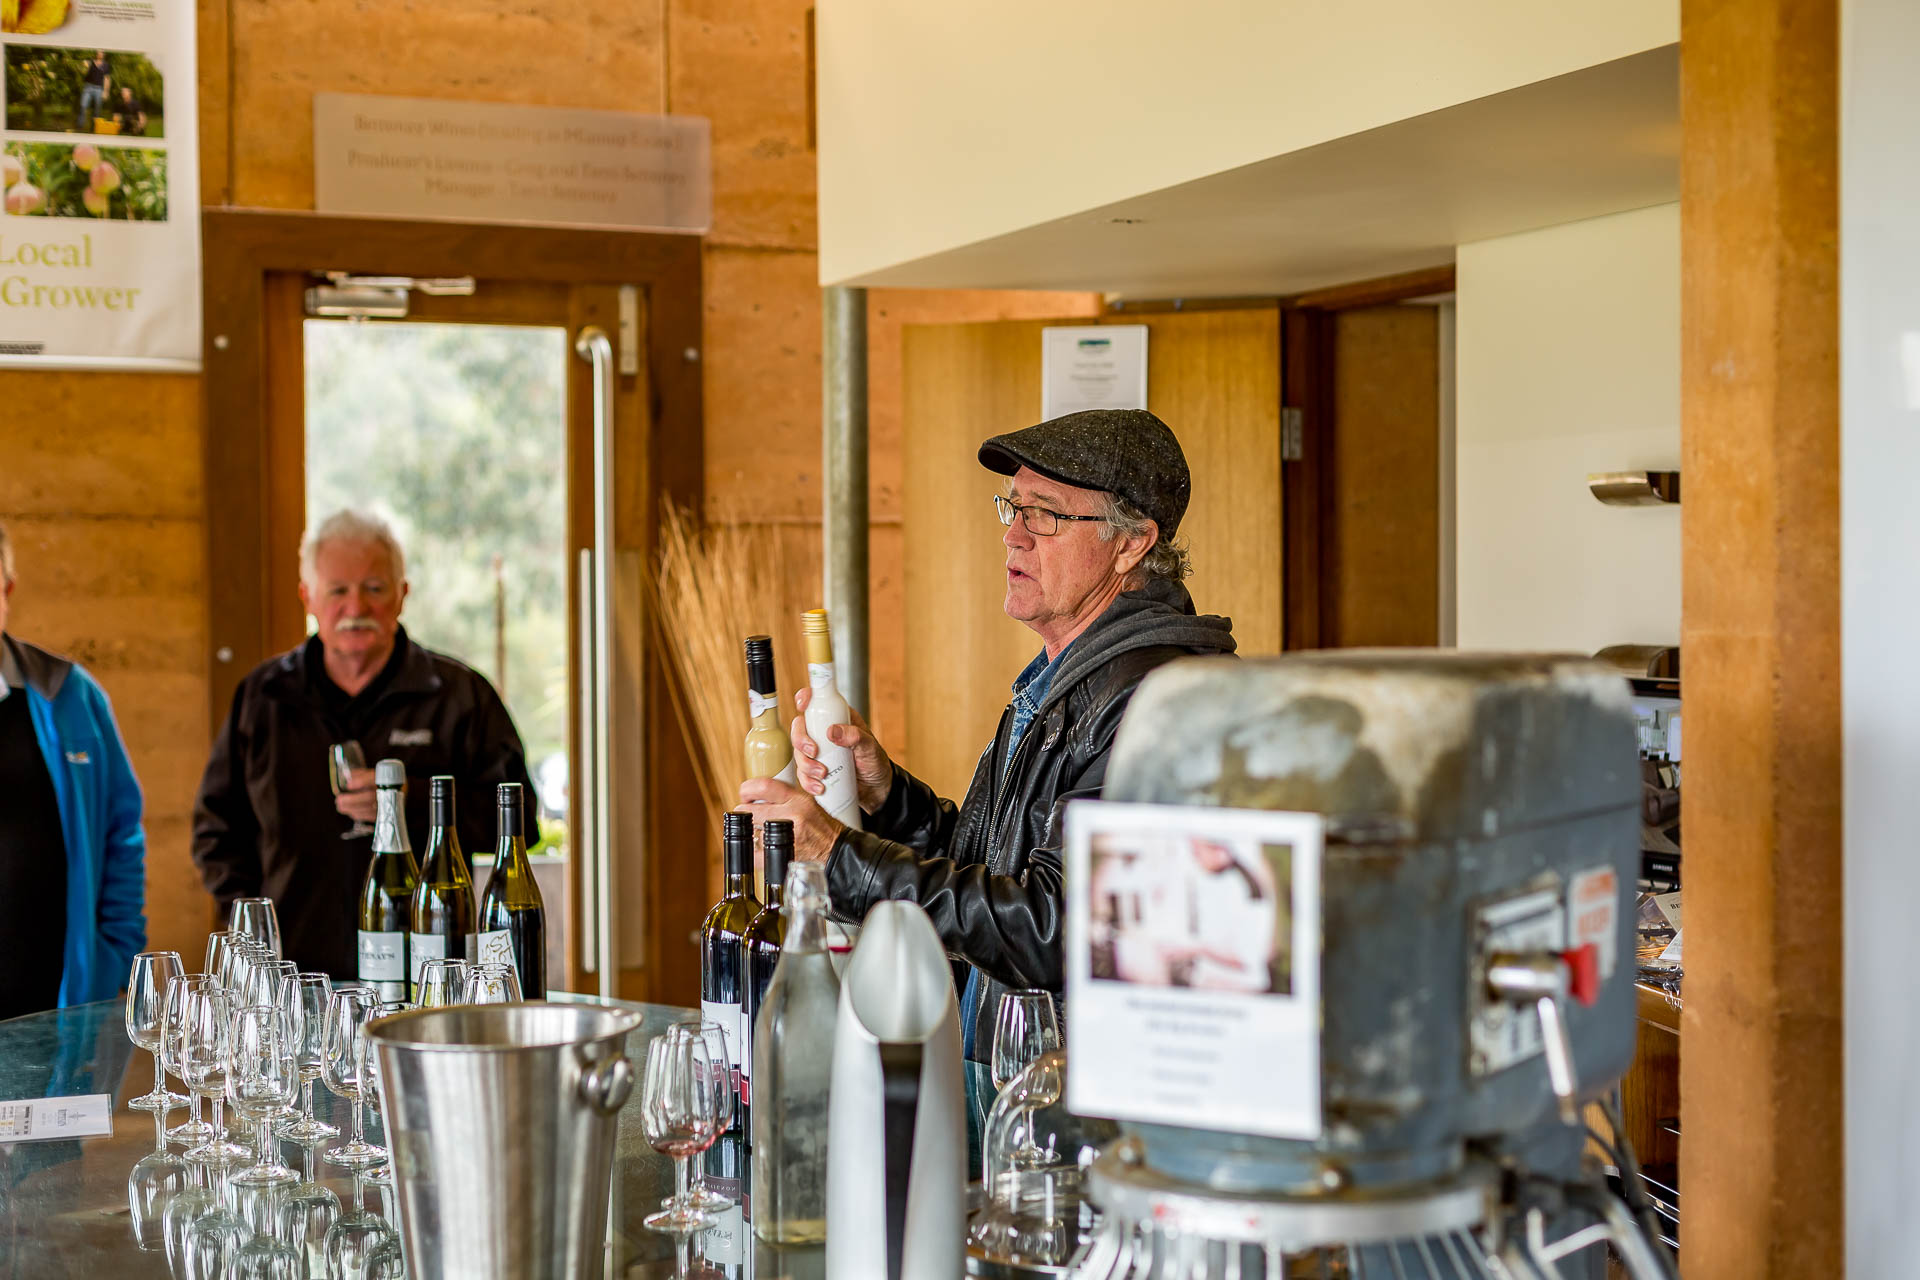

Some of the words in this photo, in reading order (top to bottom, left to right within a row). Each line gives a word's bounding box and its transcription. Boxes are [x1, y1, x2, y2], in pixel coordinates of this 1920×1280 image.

[427, 118, 477, 137] Wines
[347, 150, 431, 169] Producer's
[425, 178, 495, 198] Manager
[1, 275, 141, 312] Grower
